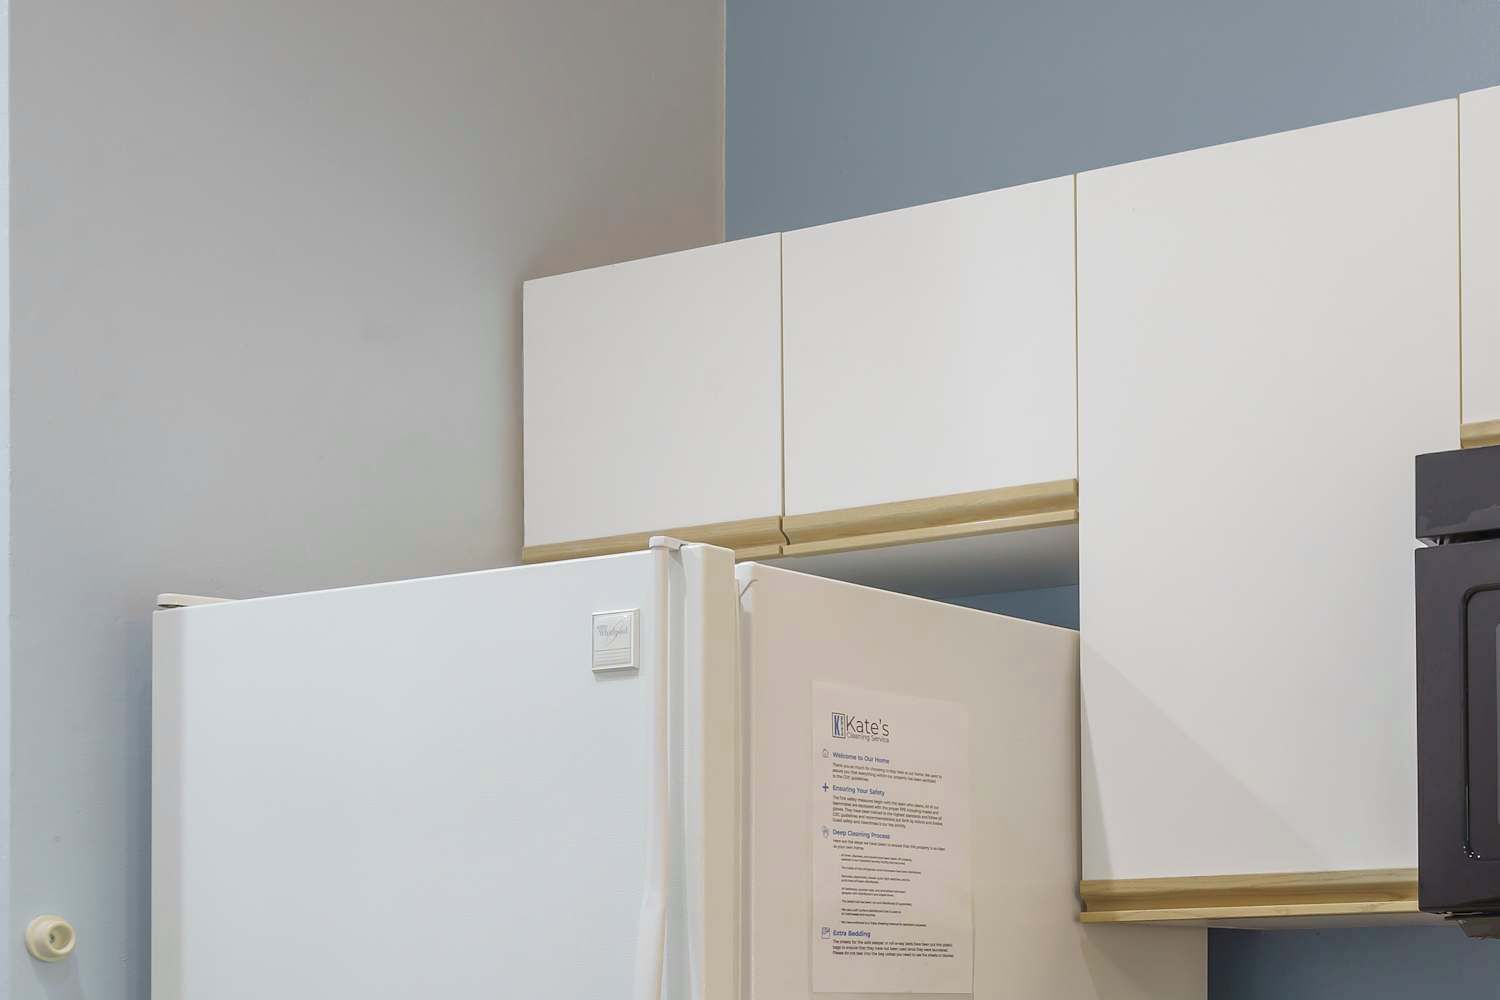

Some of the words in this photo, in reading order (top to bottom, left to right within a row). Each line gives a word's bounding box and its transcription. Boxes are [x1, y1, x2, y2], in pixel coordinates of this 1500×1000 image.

[846, 714, 890, 737] Kate's
[832, 829, 847, 837] Deep
[832, 929, 847, 937] Extra
[847, 930, 871, 939] Bedding
